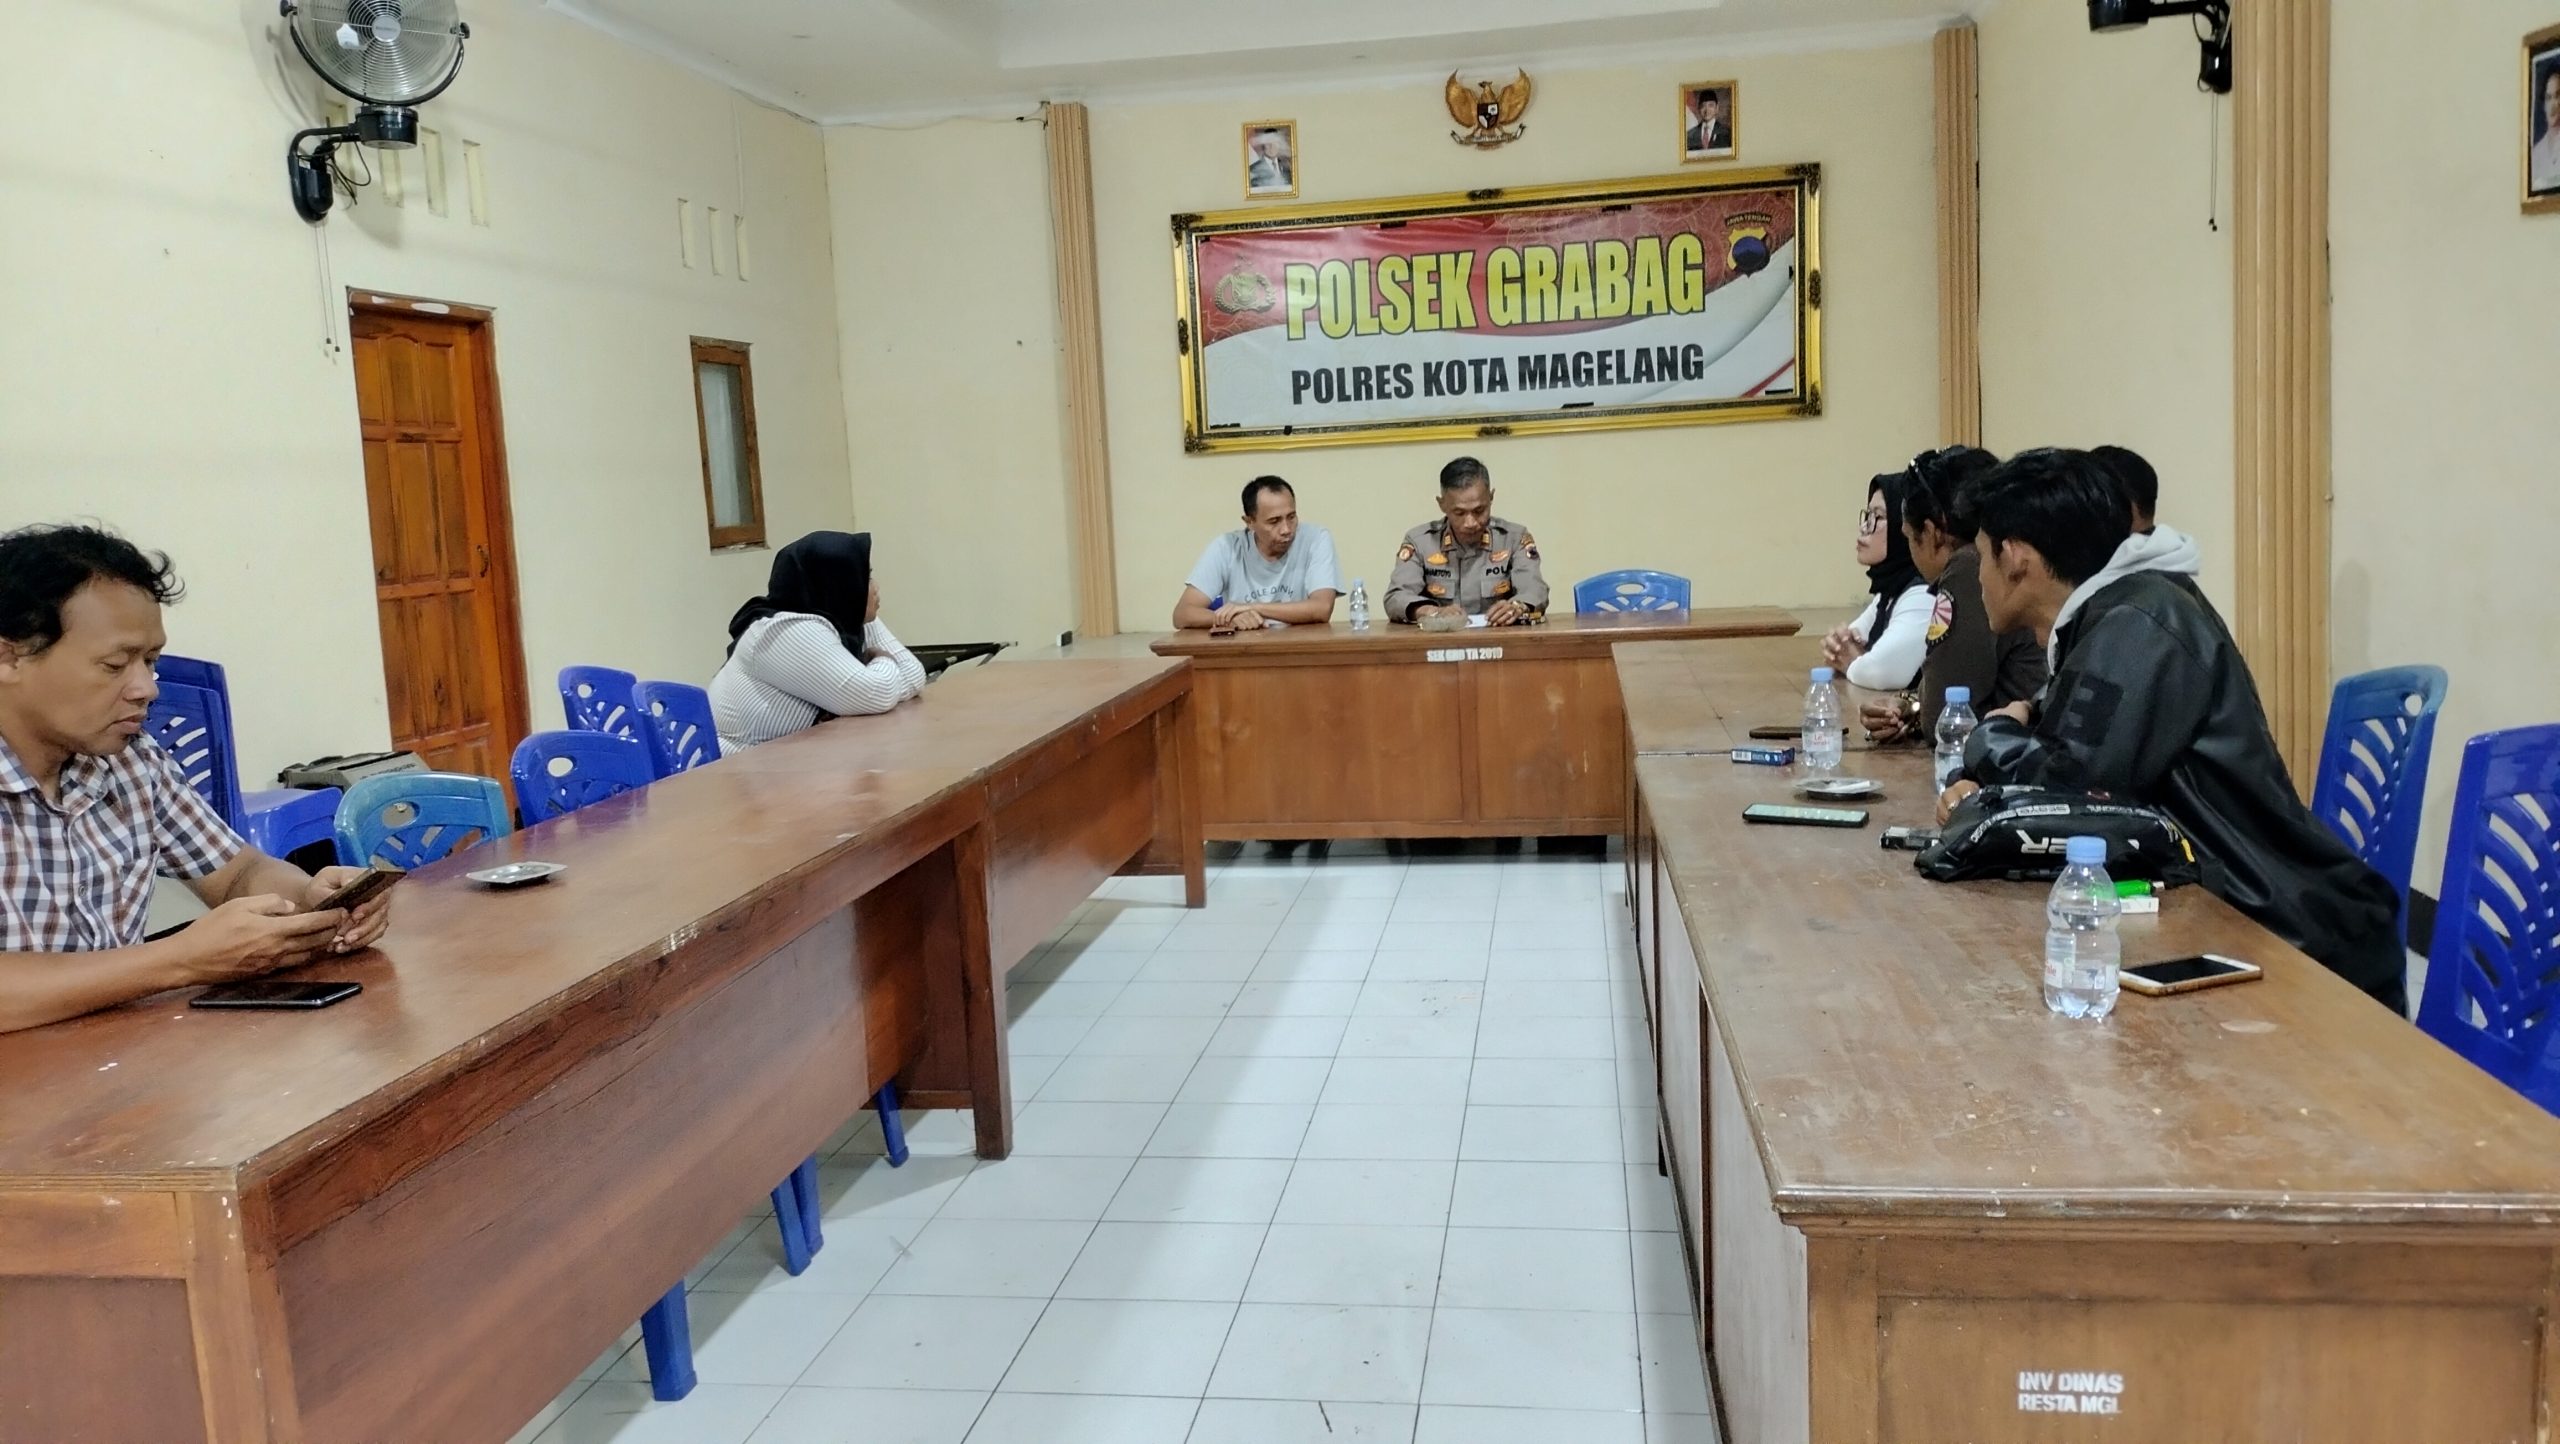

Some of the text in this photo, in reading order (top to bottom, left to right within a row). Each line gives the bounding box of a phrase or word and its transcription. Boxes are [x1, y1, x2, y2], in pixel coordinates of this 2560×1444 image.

[1284, 232, 1706, 341] POLSEK GRABAG
[1291, 344, 1704, 405] POLRES KOTA MAGELANG
[2018, 1393, 2079, 1412] RESTA
[2019, 1371, 2124, 1393] INV DINAS
